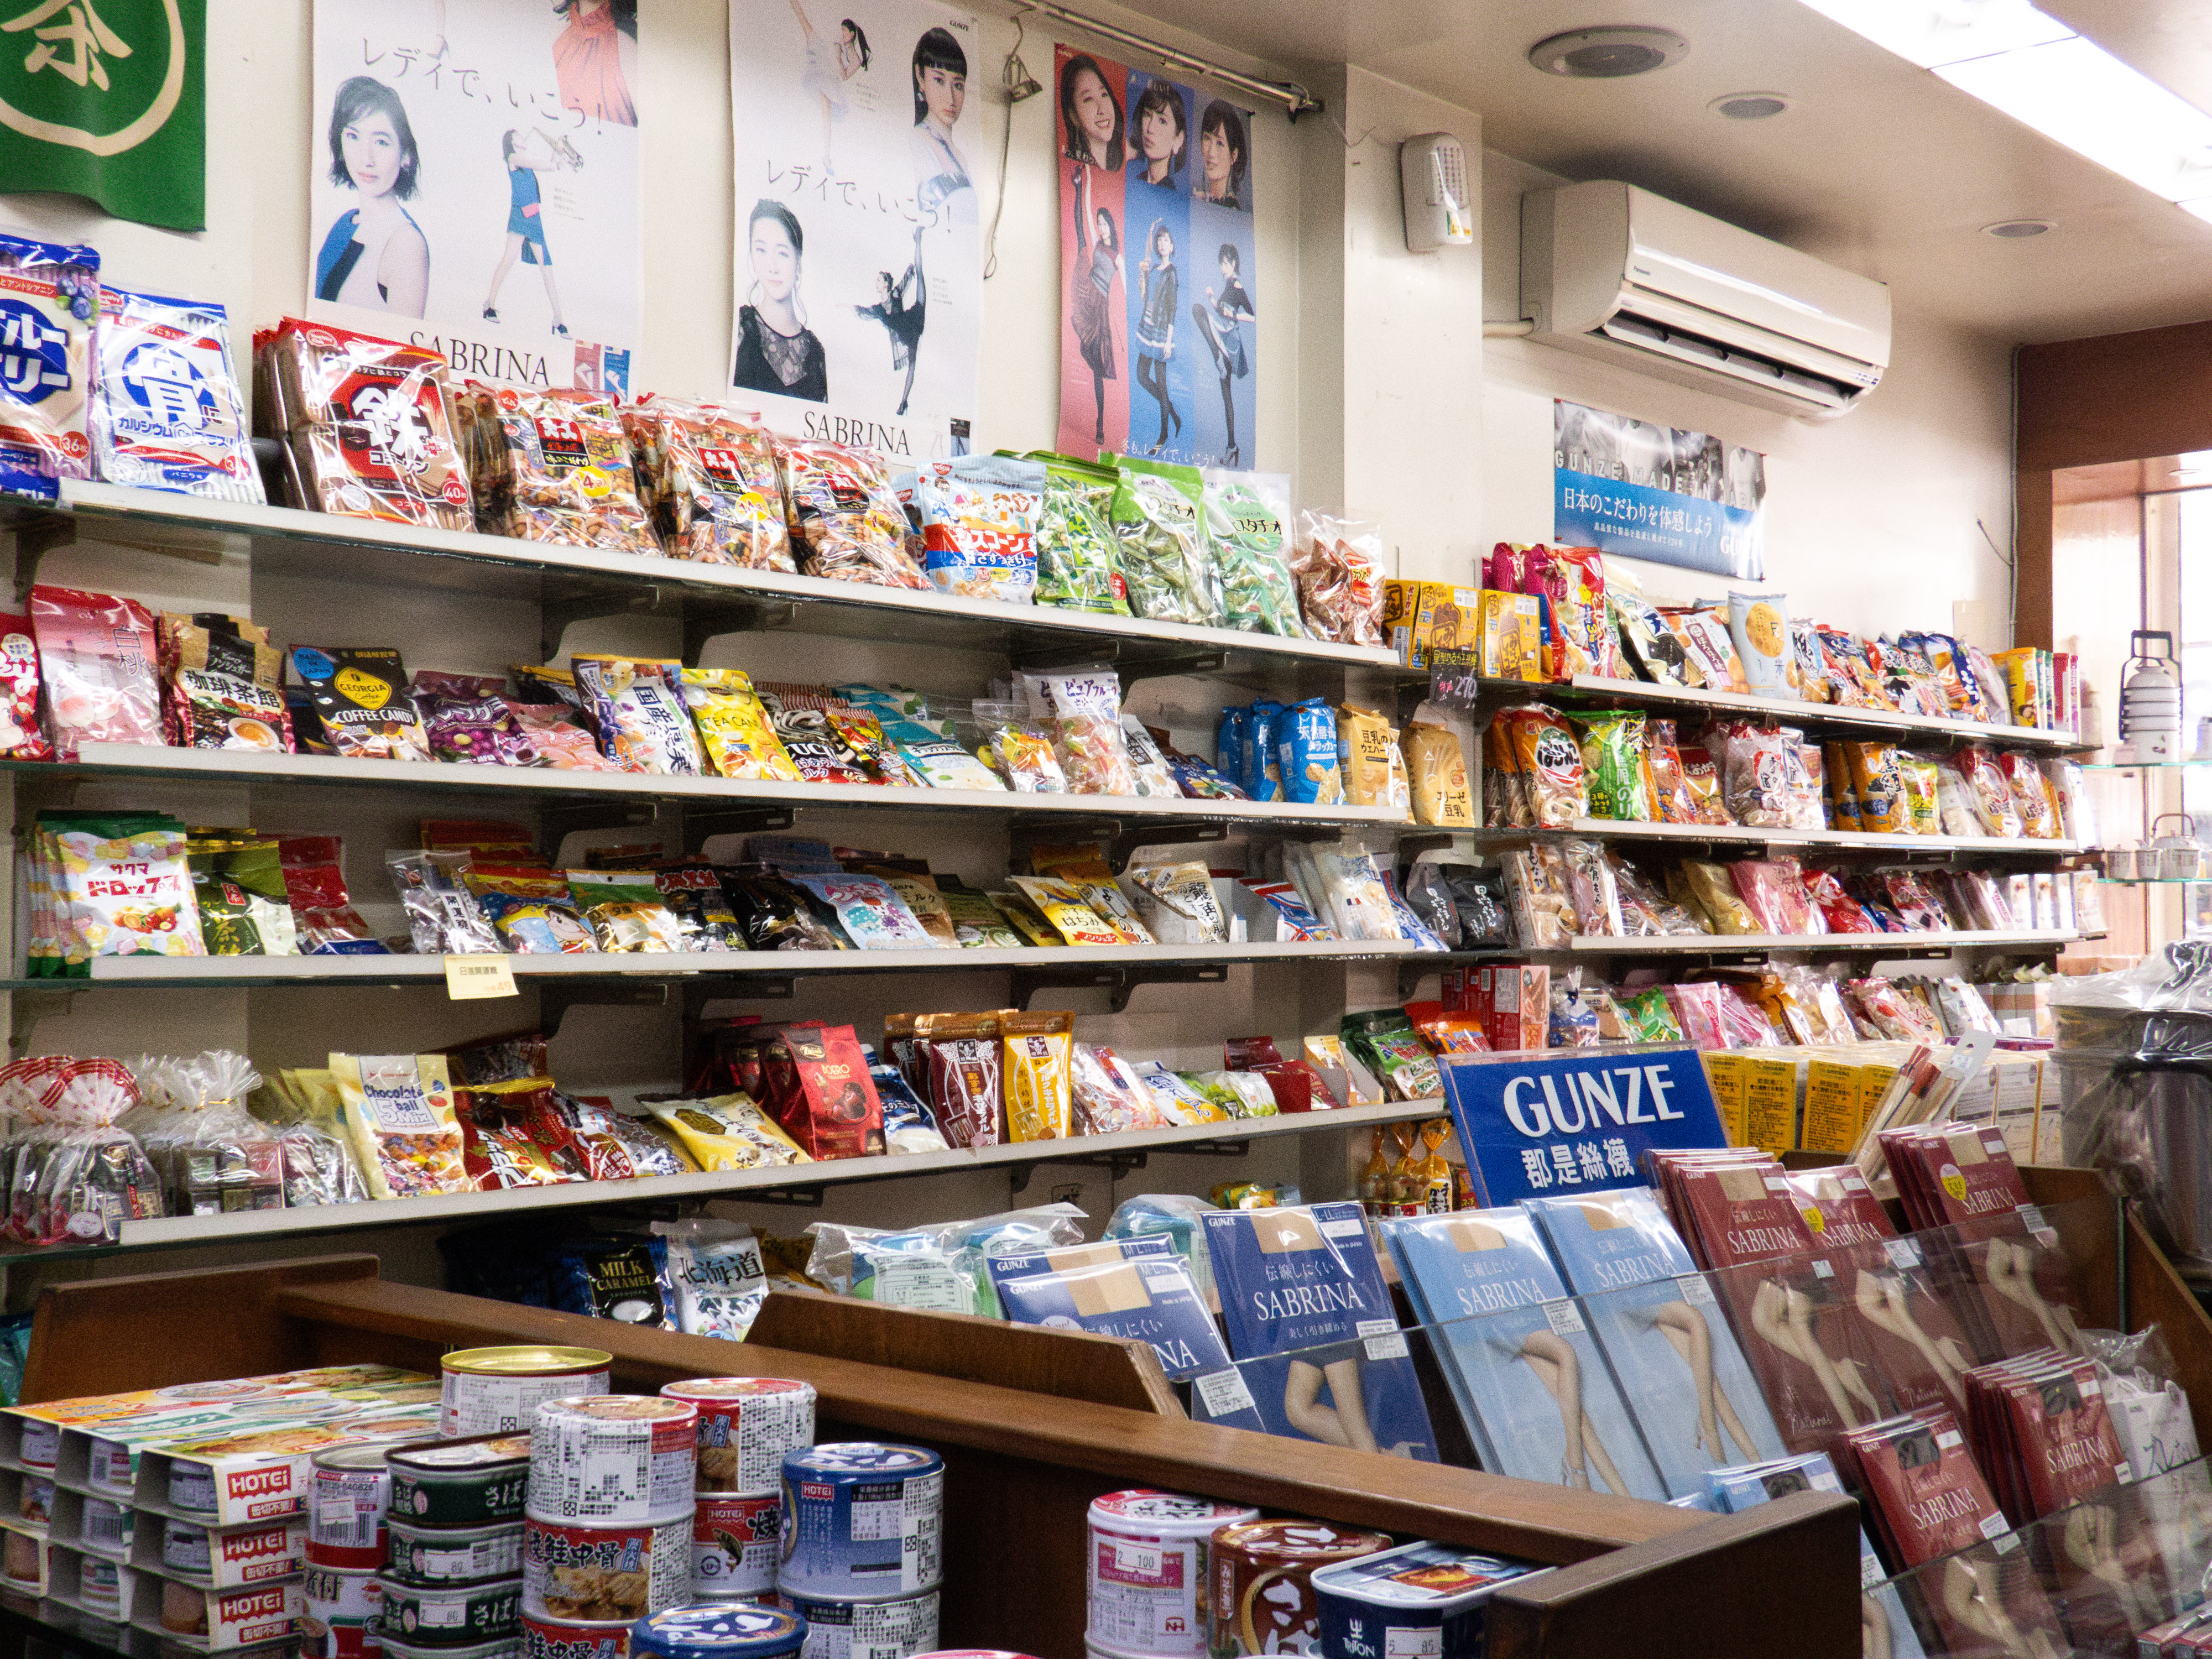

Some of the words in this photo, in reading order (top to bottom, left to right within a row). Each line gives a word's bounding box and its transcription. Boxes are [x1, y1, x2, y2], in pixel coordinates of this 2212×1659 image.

[0, 310, 66, 349] ルー
[409, 331, 550, 386] SABRINA
[802, 410, 911, 456] SABRINA
[1560, 450, 1627, 481] GUNZE
[1636, 467, 1688, 494] MADE
[1569, 487, 1718, 538] 日本のこだわりを体感しよう
[184, 670, 280, 709] 珈琲茶館
[339, 683, 387, 692] GEORGIA
[1455, 675, 1477, 699] 270
[336, 709, 380, 723] COFFEE
[381, 709, 414, 724] CANDY
[705, 717, 731, 728] TEA
[732, 717, 761, 728] CAN
[1297, 725, 1336, 740] 天酵母
[1360, 744, 1390, 754] ウエハー
[1443, 804, 1465, 817] 豆乳
[109, 863, 150, 875] サクマ
[87, 875, 182, 898] ドロップス
[821, 1064, 850, 1075] BOERO
[363, 1084, 424, 1099] Chocolate
[1503, 1064, 1684, 1138] GUNZE
[376, 1098, 395, 1123] 5
[398, 1111, 428, 1124] Mix
[395, 1100, 419, 1111] ball
[1521, 1138, 1635, 1189] 郡是絲襪
[1962, 1187, 2016, 1215] SABRINA
[1208, 1216, 1237, 1228] GUNZE
[1727, 1225, 1801, 1255] SABRINA
[1821, 1222, 1881, 1248] SABRINA
[599, 1260, 644, 1277] MILK
[680, 1254, 764, 1286] 北海道
[997, 1259, 1030, 1271] GUNZE
[1594, 1252, 1677, 1288] SABRINA
[596, 1275, 655, 1292] CARAMEL
[1253, 1280, 1365, 1322] SABRINA
[1457, 1278, 1545, 1315] SABRINA
[2046, 1437, 2109, 1473] SABRINA
[231, 1469, 288, 1493] HOTEi
[1908, 1486, 1980, 1530] SABRINA
[226, 1543, 284, 1567] HOTEi
[1137, 1554, 1154, 1568] 100
[223, 1594, 281, 1616] HOTEi
[1343, 1636, 1375, 1657] TRITON
